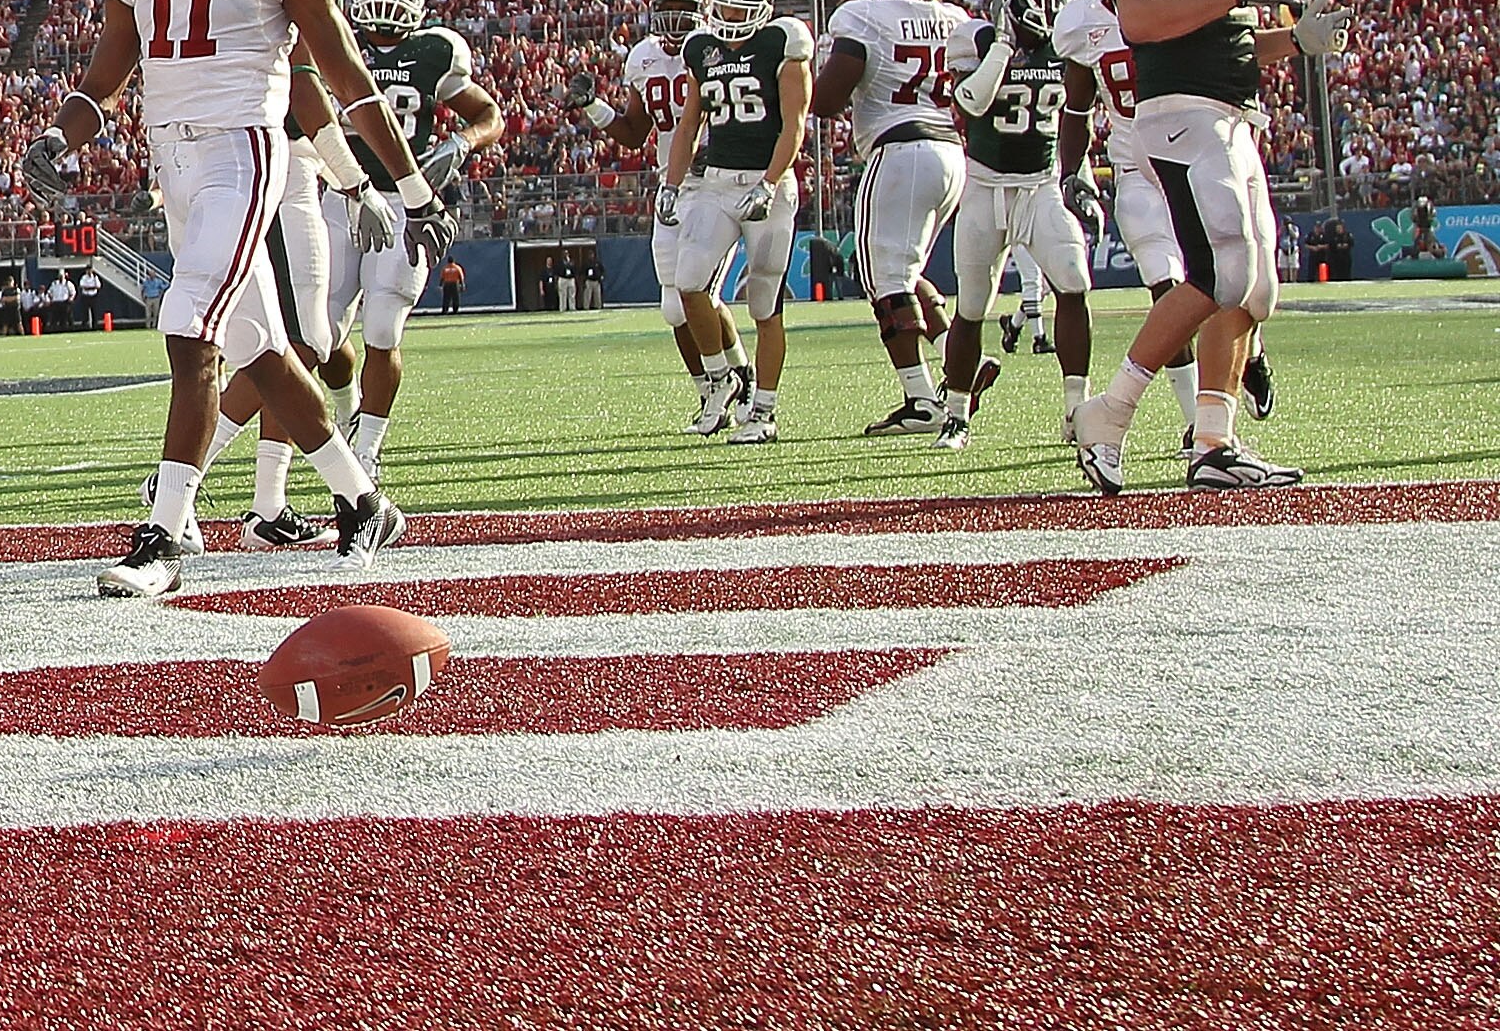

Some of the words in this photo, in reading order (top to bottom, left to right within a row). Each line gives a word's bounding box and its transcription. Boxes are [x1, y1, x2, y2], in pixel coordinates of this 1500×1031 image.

[707, 63, 751, 77] SPARTANS
[1010, 69, 1062, 81] SPARTANS
[700, 76, 767, 126] 36
[993, 83, 1067, 134] 39
[62, 226, 96, 255] 40
